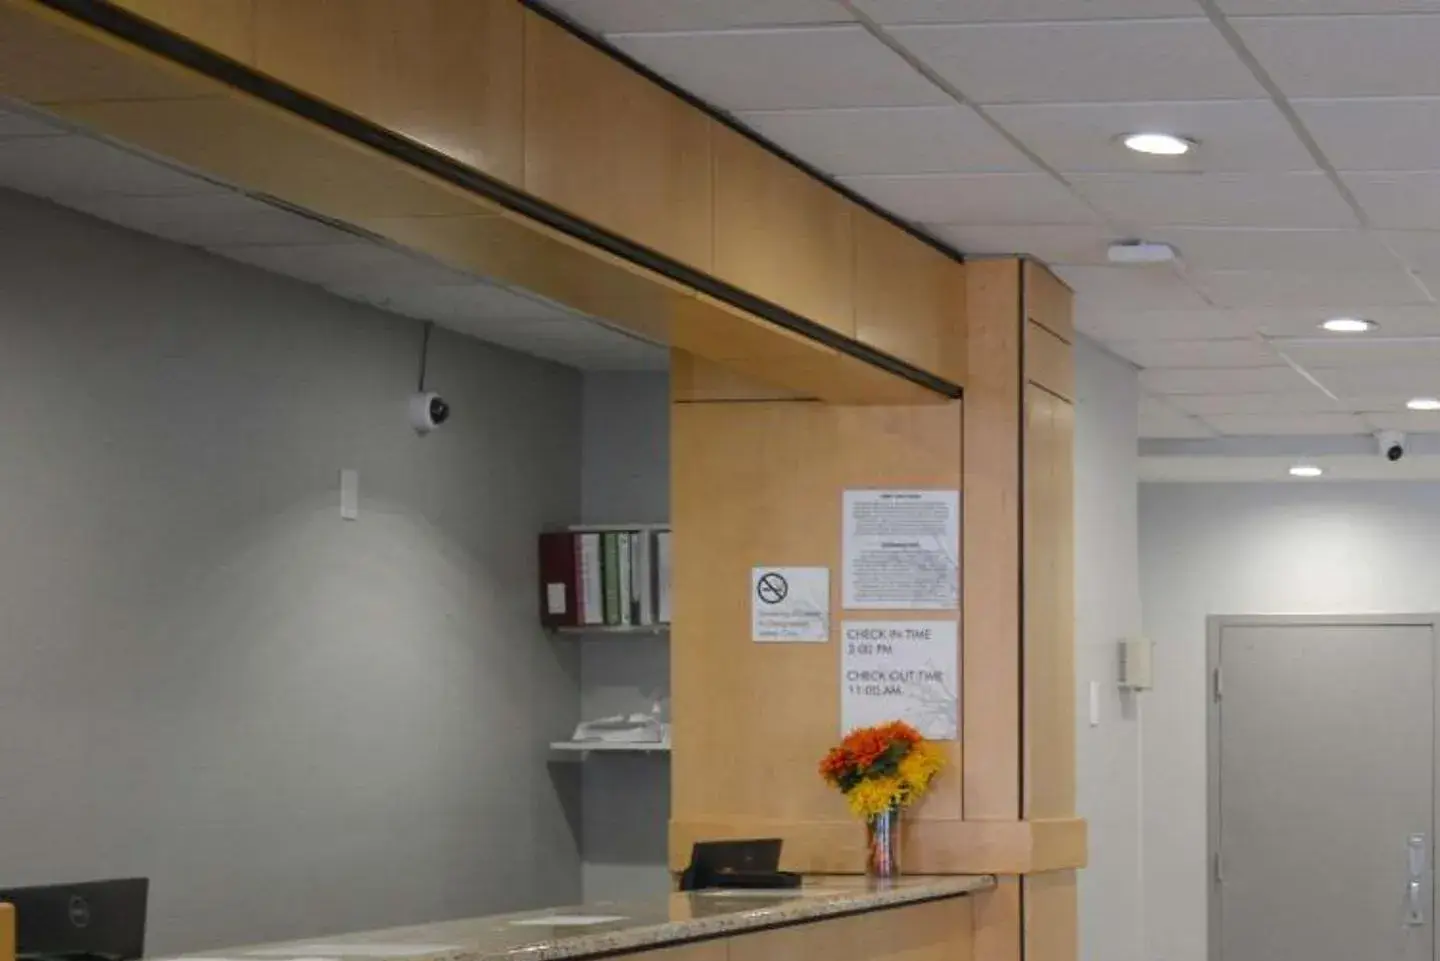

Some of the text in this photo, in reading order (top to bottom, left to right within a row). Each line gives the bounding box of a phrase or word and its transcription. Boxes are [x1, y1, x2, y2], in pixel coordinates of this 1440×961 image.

[846, 629, 886, 640] CHECK
[905, 629, 933, 640] TIME
[876, 644, 893, 655] PM
[846, 670, 944, 682] CHECK OUT TIME
